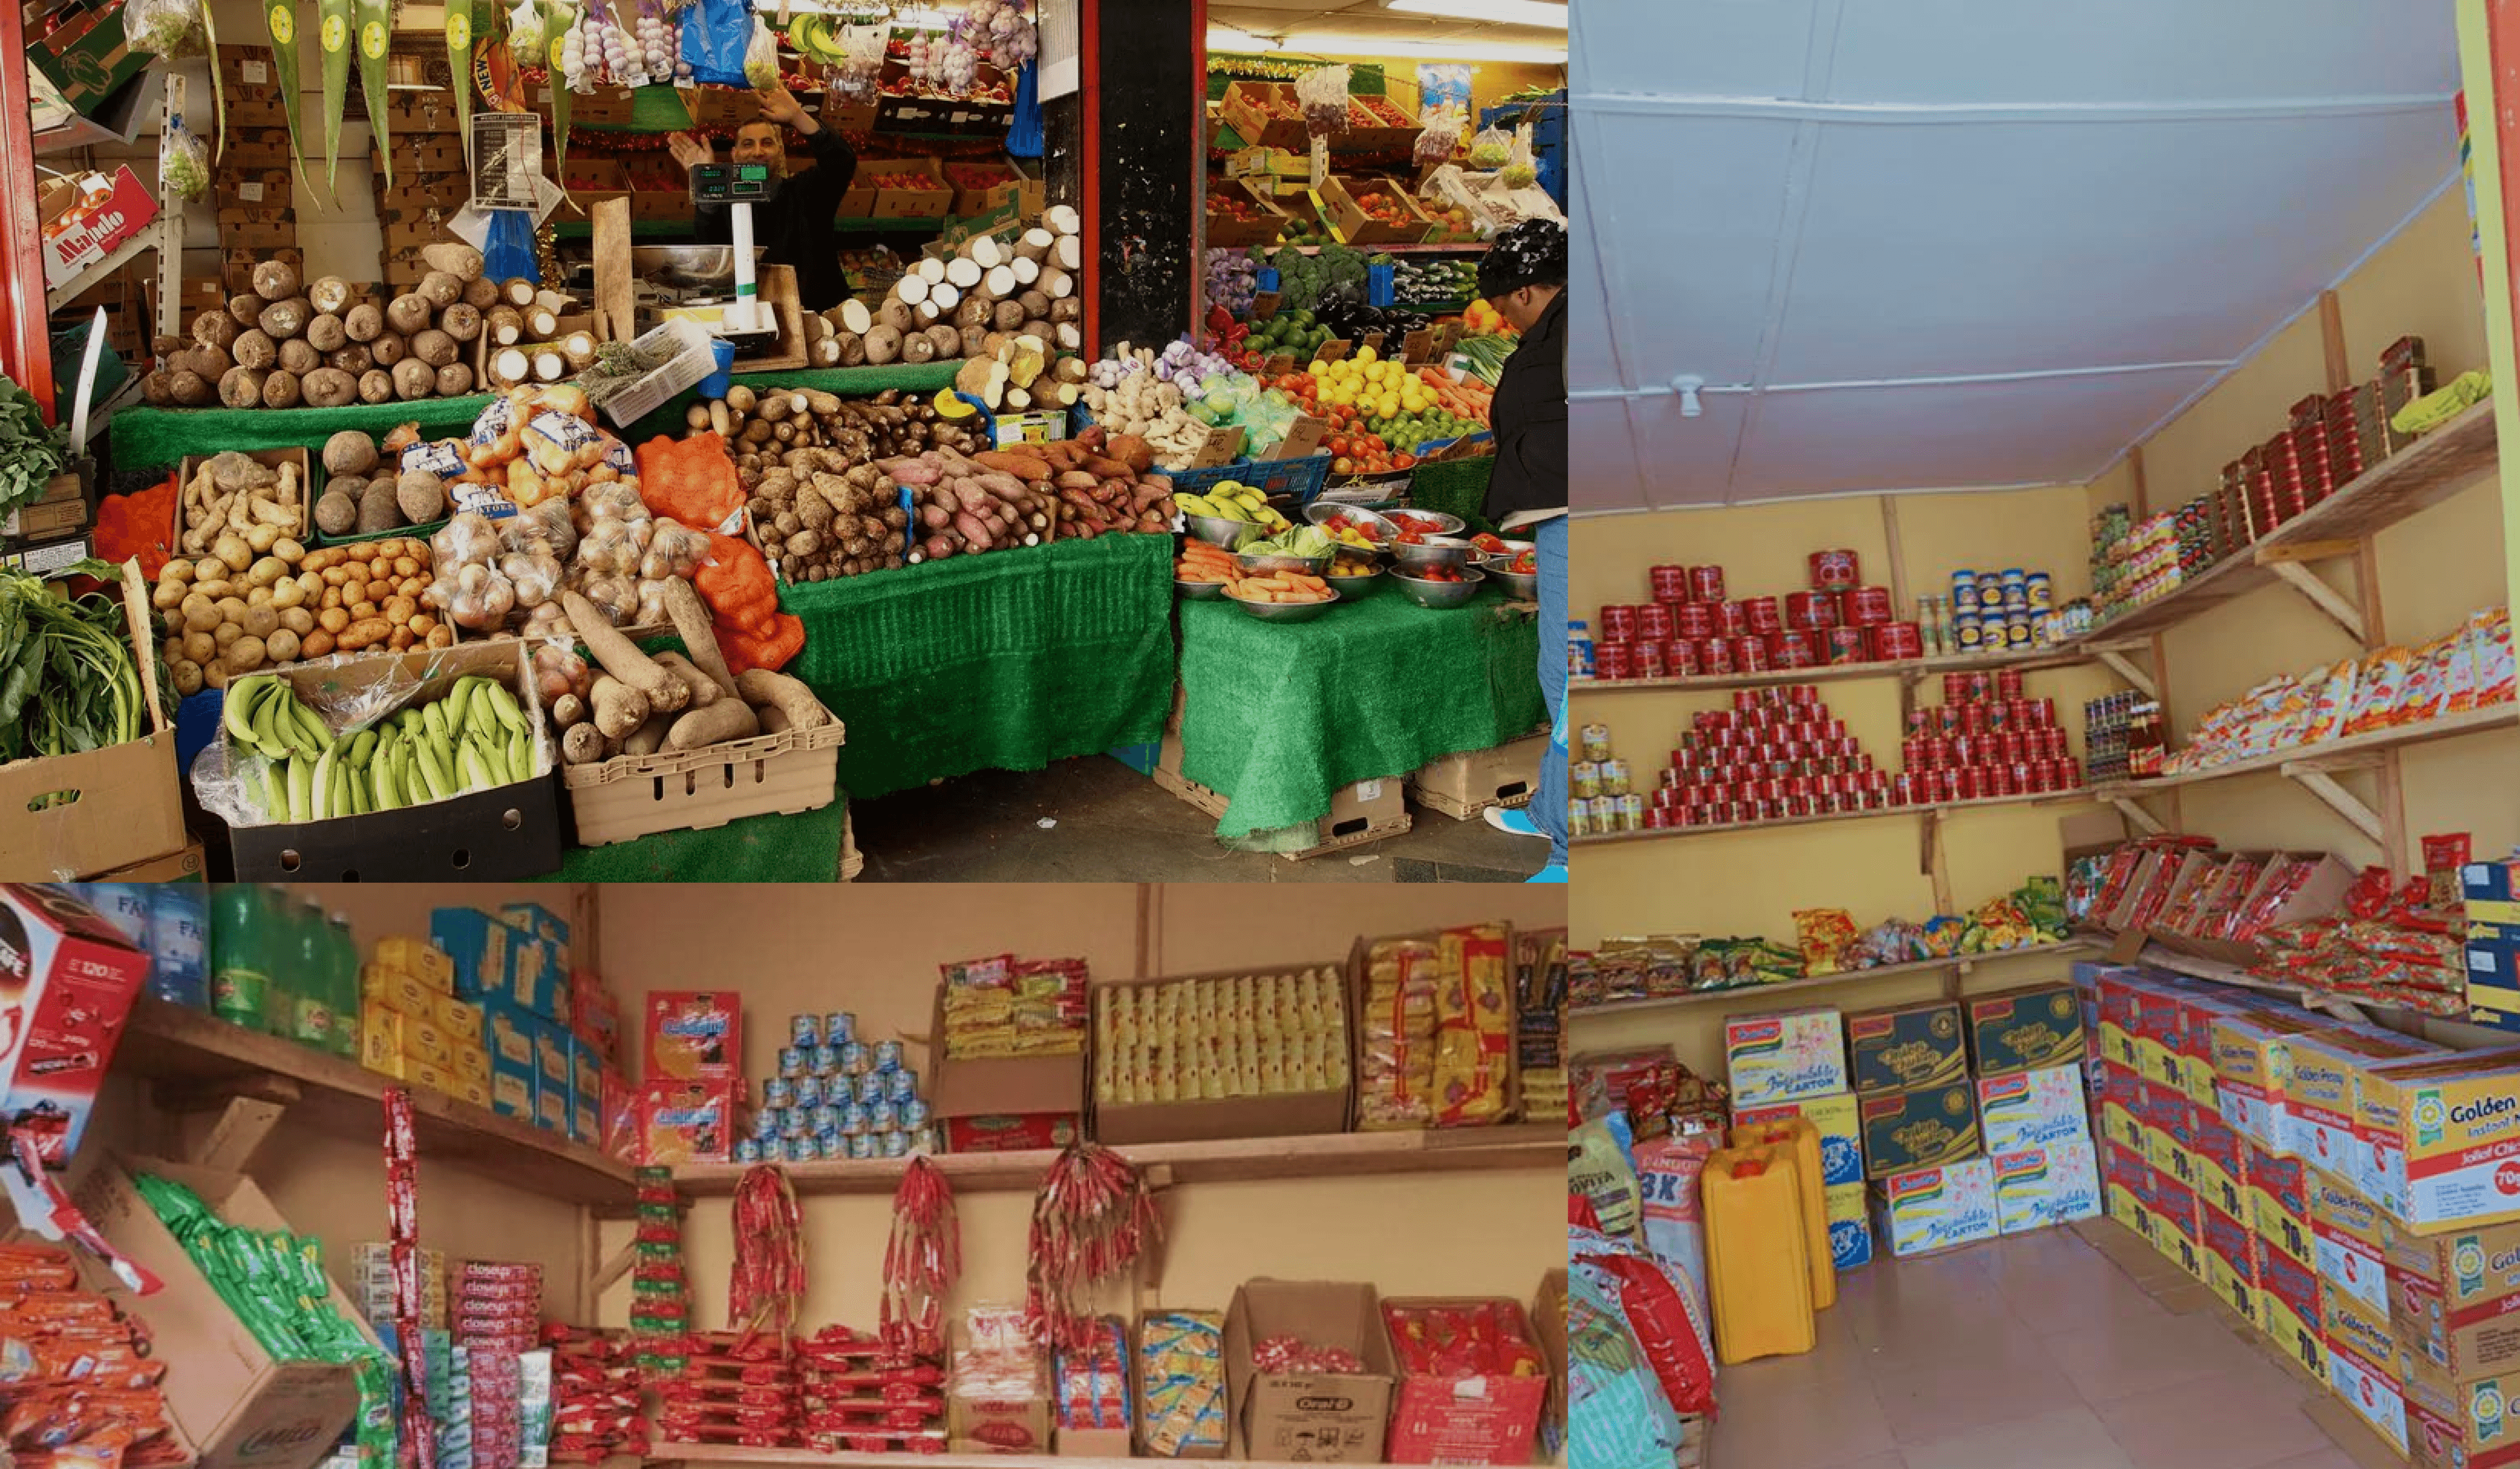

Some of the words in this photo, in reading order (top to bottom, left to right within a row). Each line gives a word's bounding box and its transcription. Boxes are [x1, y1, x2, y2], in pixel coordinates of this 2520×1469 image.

[475, 59, 492, 91] NEW
[56, 211, 125, 264] Mando
[1786, 1077, 1834, 1094] CARTON
[2450, 1096, 2517, 1124] Golden
